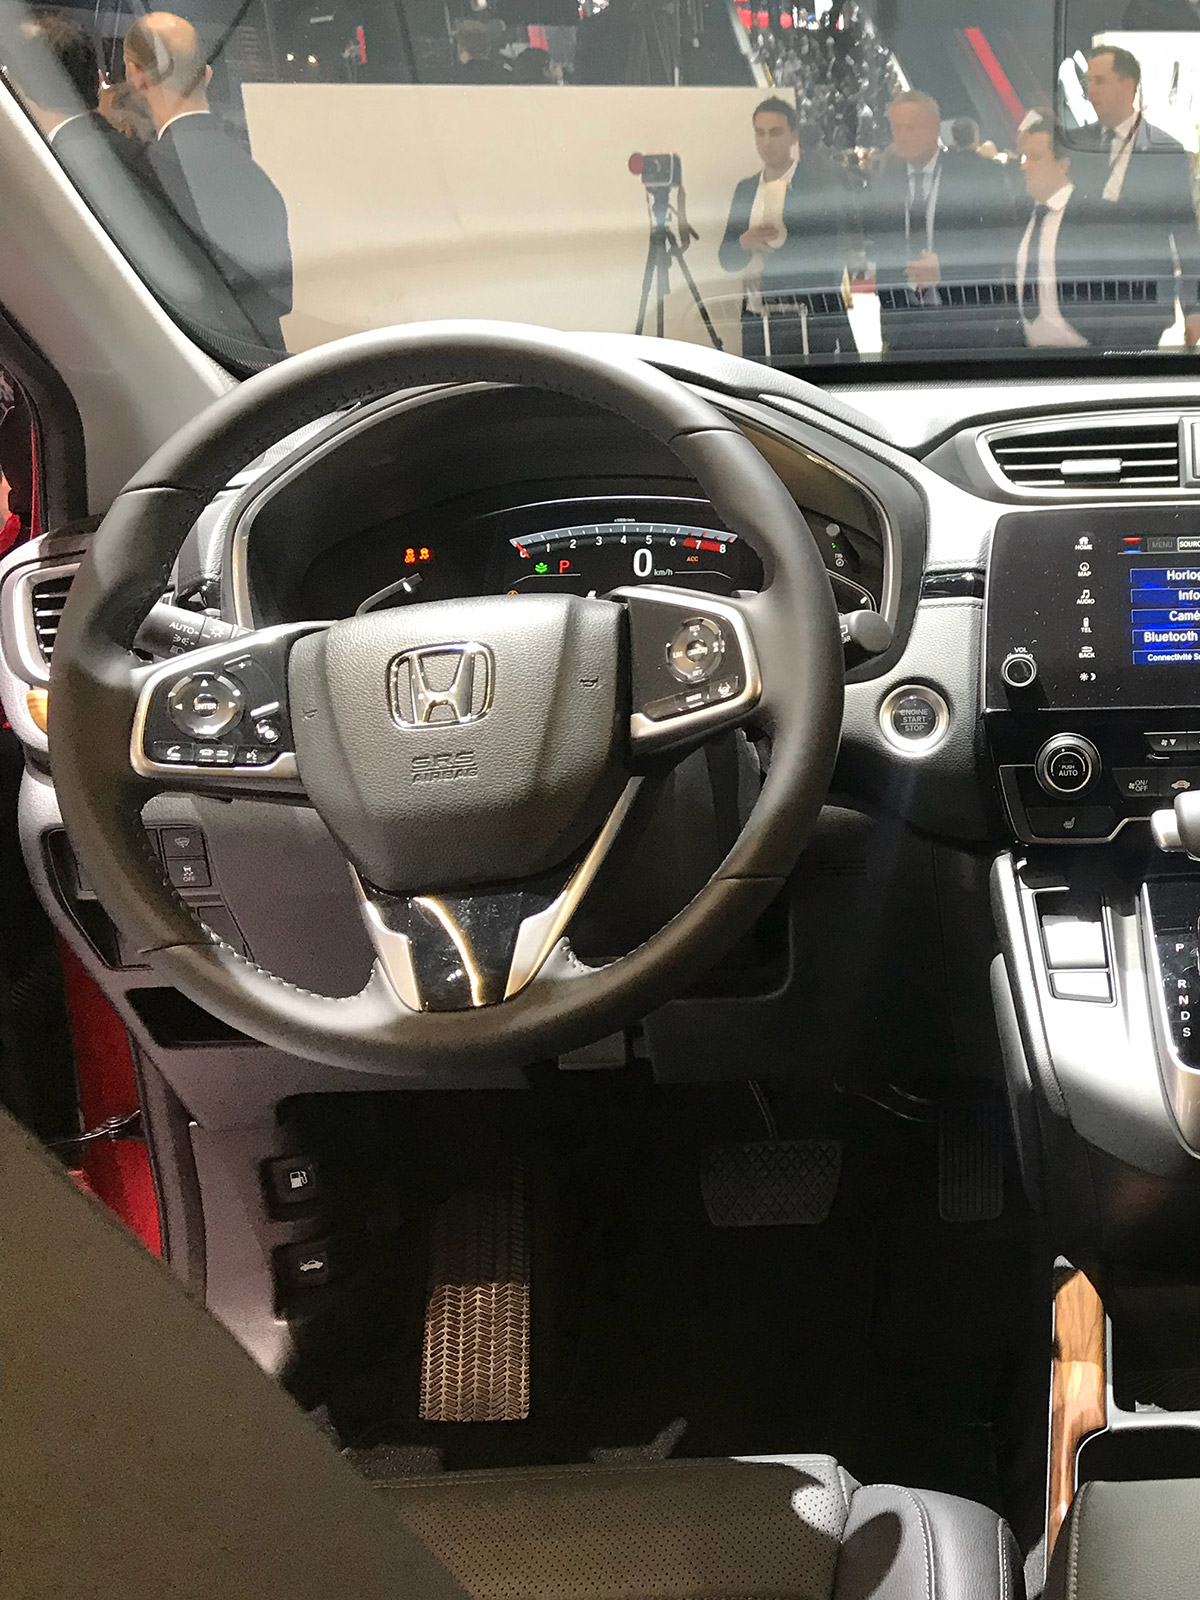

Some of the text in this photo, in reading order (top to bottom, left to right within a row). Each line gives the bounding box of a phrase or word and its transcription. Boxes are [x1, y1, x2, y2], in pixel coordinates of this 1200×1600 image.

[545, 543, 551, 553] 1
[569, 538, 577, 549] 2
[595, 535, 603, 546] 3
[620, 534, 627, 545] 4
[645, 535, 653, 545] 5
[669, 537, 677, 547] 6
[695, 539, 701, 550] 7
[719, 543, 726, 554] 8
[559, 559, 571, 573] P
[633, 548, 673, 577] 0 km/h
[1178, 590, 1200, 601] Info
[169, 622, 194, 635] AUTO
[1144, 631, 1198, 642] Bluetooth
[1147, 654, 1192, 662] Connectivité
[900, 708, 929, 716] ENGINE
[411, 751, 476, 768] SRS
[411, 769, 478, 786] AIRBAG
[1175, 943, 1185, 952] P
[1177, 979, 1187, 989] R
[1178, 995, 1189, 1005] N
[1180, 1011, 1191, 1021] D
[1182, 1027, 1192, 1037] S
